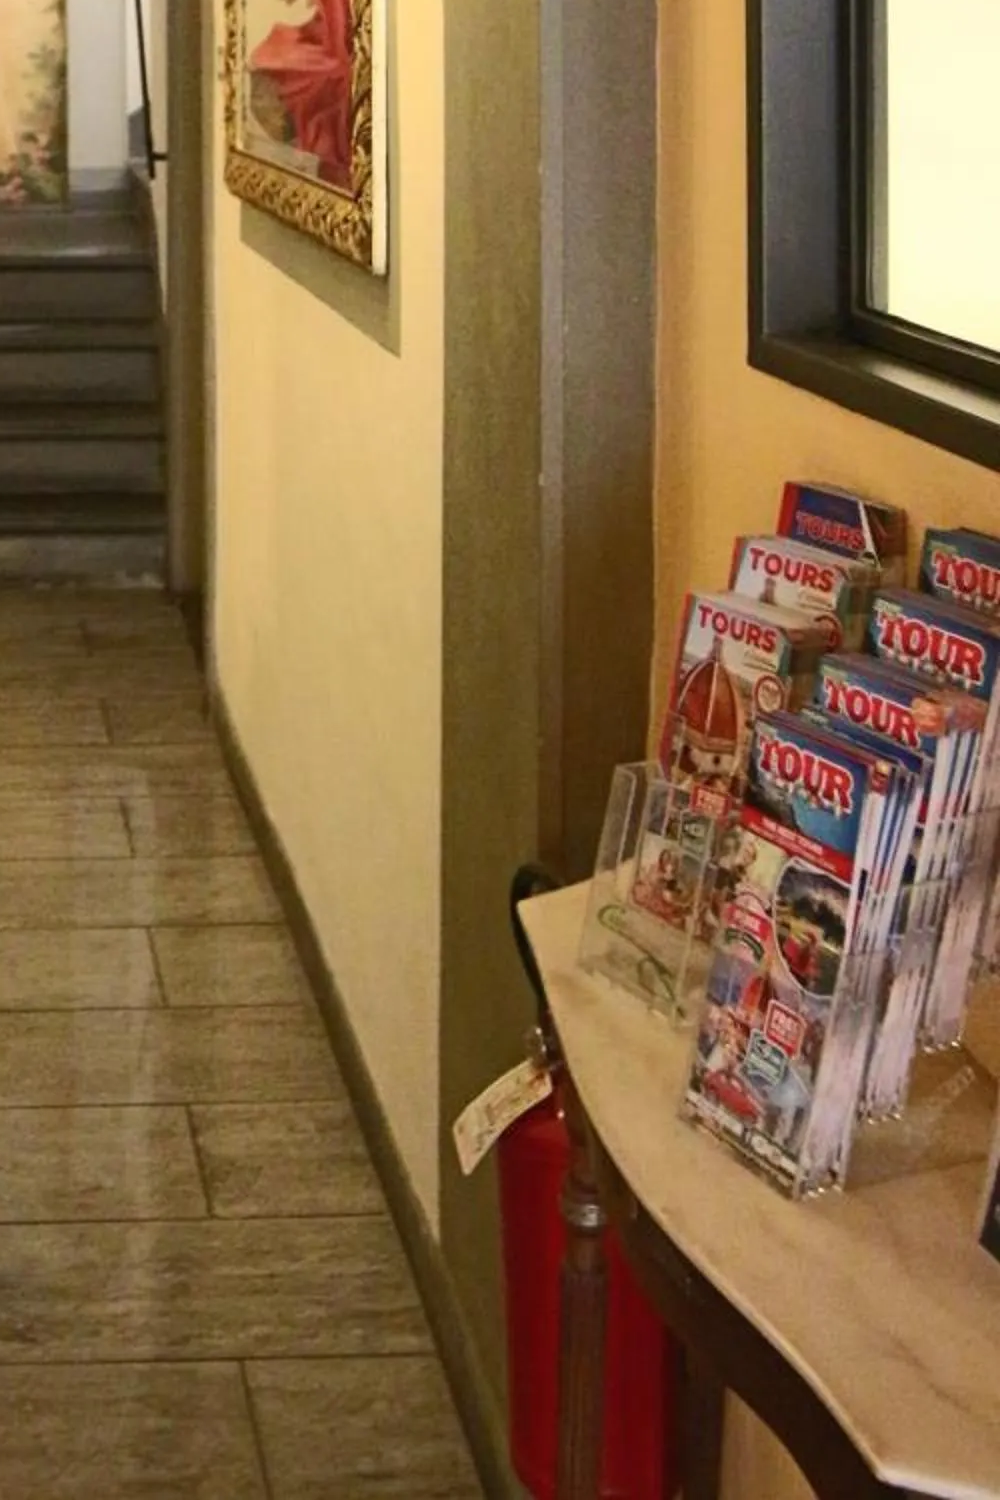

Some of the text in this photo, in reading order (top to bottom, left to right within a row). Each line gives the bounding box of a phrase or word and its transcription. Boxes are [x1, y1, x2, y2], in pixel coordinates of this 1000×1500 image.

[796, 510, 867, 551] TOURS
[749, 547, 835, 593] TOURS
[698, 604, 778, 654] TOURS
[878, 612, 985, 685] TOUR
[823, 676, 921, 749] TOUR
[759, 735, 853, 812] TOUR
